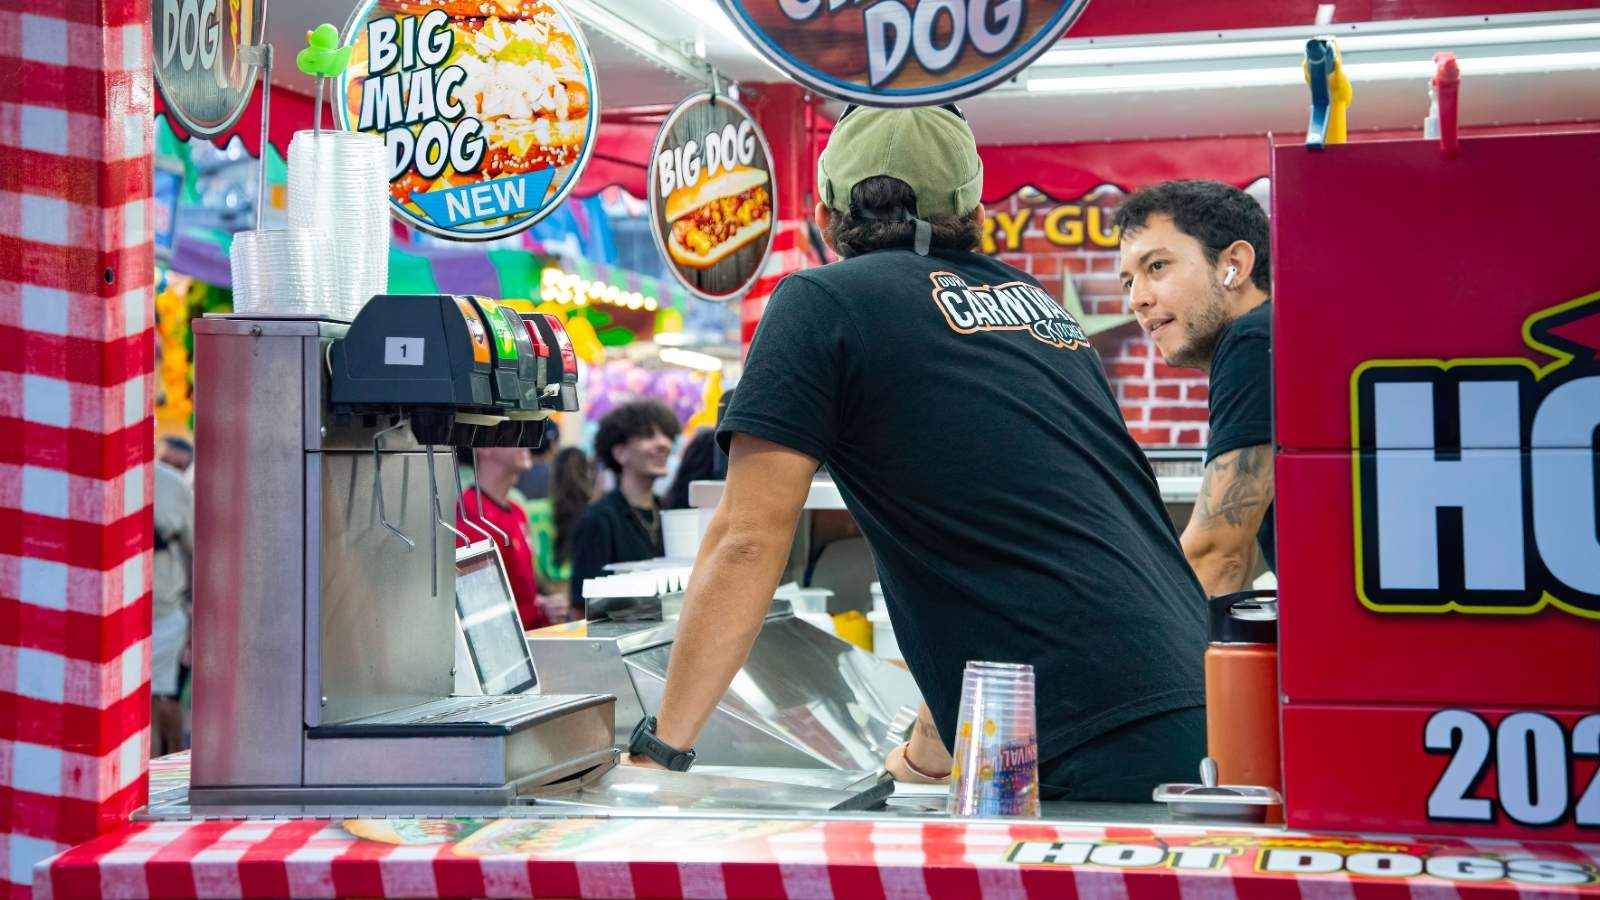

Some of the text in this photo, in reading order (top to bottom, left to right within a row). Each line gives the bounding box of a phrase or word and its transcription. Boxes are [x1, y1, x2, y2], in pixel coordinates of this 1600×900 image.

[162, 0, 219, 70] DOG
[367, 9, 454, 75] BIG
[864, 0, 1022, 87] DOG
[358, 65, 467, 132] MAC
[385, 117, 486, 182] DOG
[658, 119, 756, 198] BIG DOG
[445, 178, 526, 222] NEW
[940, 286, 1077, 328] CARNIVAL
[400, 343, 407, 358] 1
[1006, 841, 1238, 870] HOT
[1258, 848, 1597, 885] DOGS
